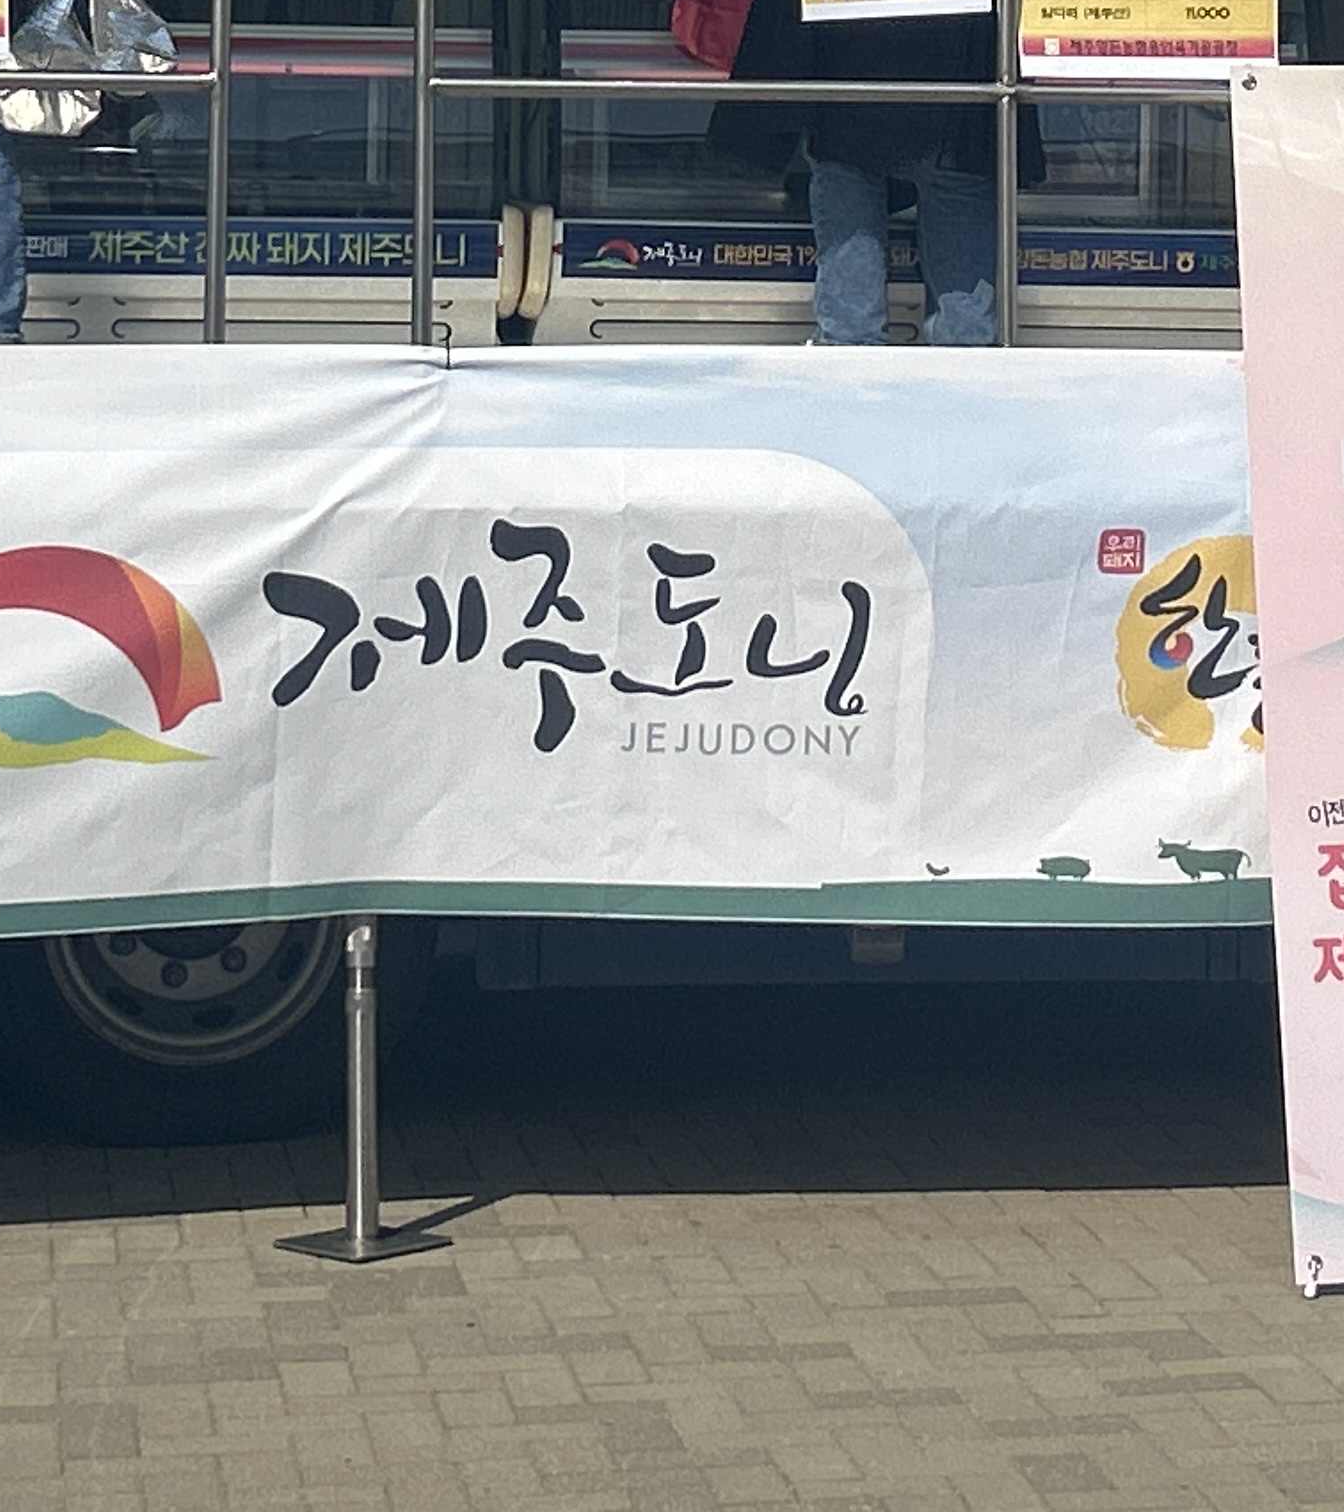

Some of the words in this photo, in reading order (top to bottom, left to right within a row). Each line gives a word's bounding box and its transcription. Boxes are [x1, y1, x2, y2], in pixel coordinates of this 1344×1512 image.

[89, 229, 190, 265] 제주산
[267, 232, 331, 267] 돼지
[714, 243, 792, 267] 대한민국
[1091, 249, 1169, 272] 제주도니
[1104, 534, 1141, 551] 우리
[1102, 552, 1141, 569] 돼지
[263, 518, 871, 753] 제주도니
[1140, 553, 1264, 735] 한
[620, 722, 863, 756] JEJUDONY
